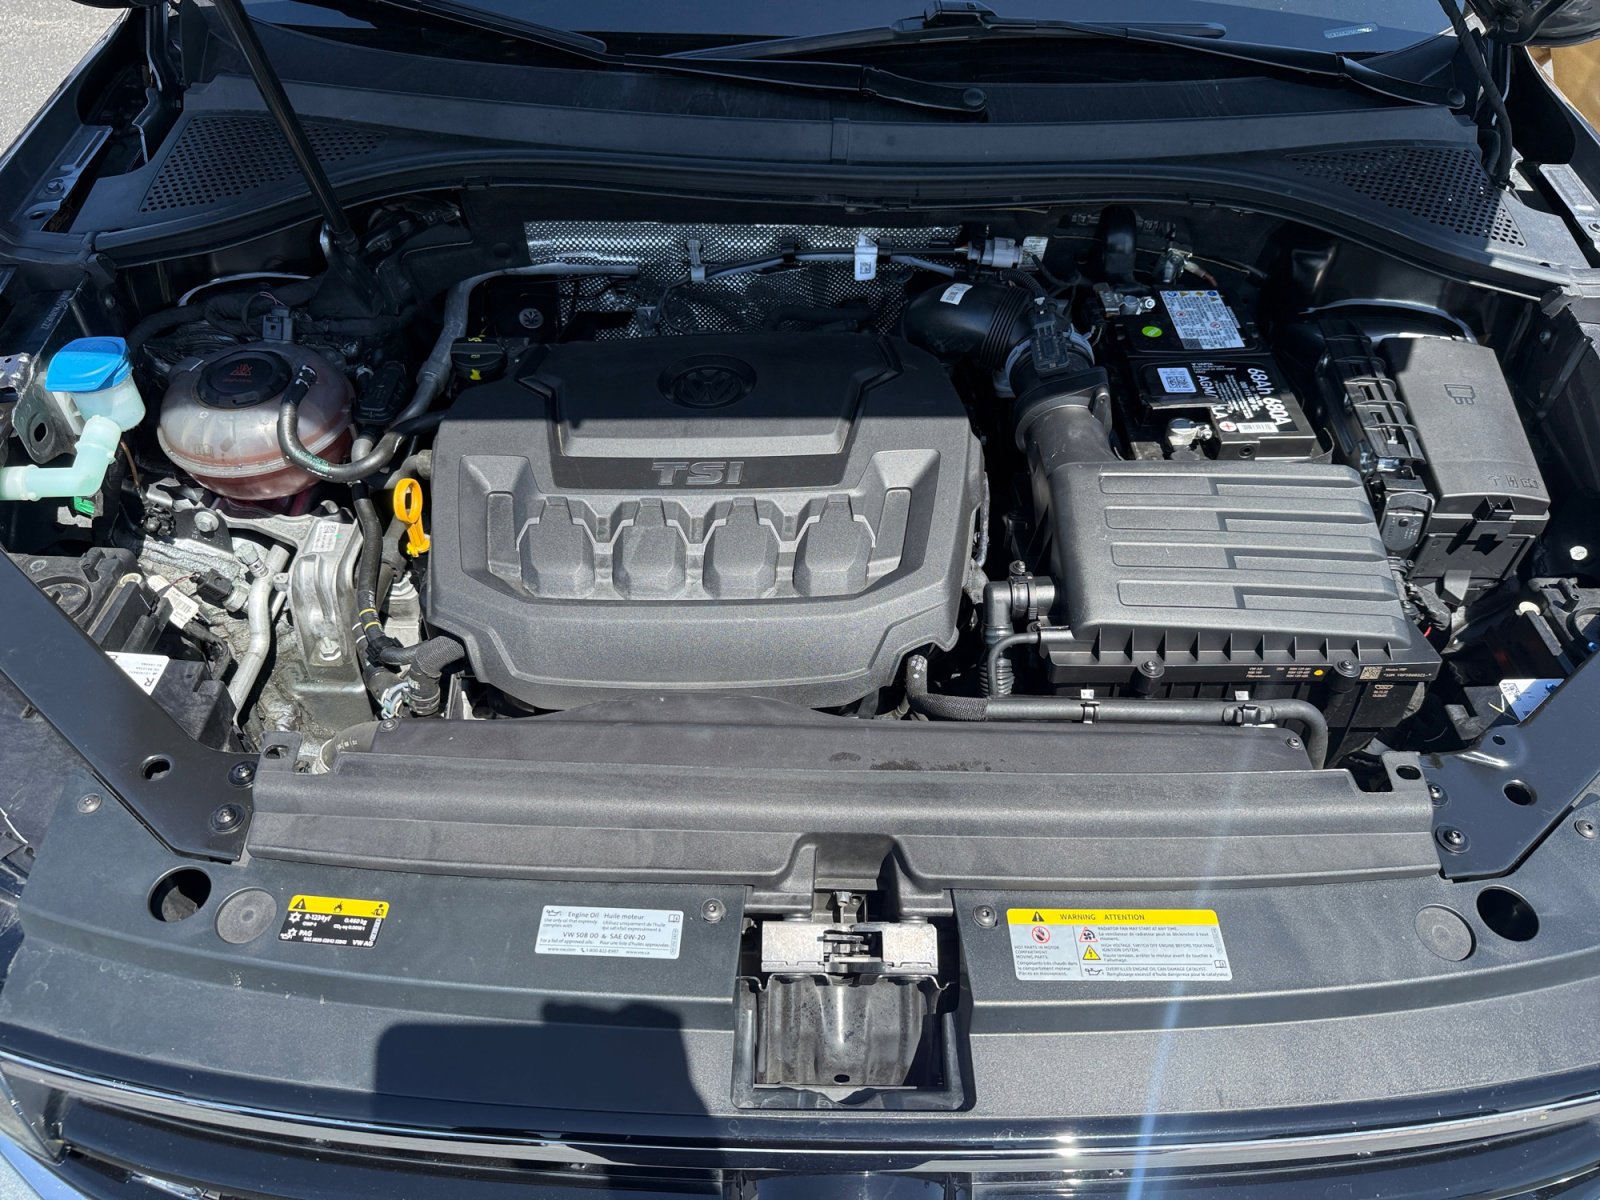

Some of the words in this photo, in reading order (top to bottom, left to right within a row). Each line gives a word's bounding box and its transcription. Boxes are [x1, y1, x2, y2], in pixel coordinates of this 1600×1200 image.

[1248, 368, 1274, 394] 68Ah
[1263, 397, 1292, 425] 680A
[652, 462, 744, 485] TSI
[144, 677, 154, 686] R
